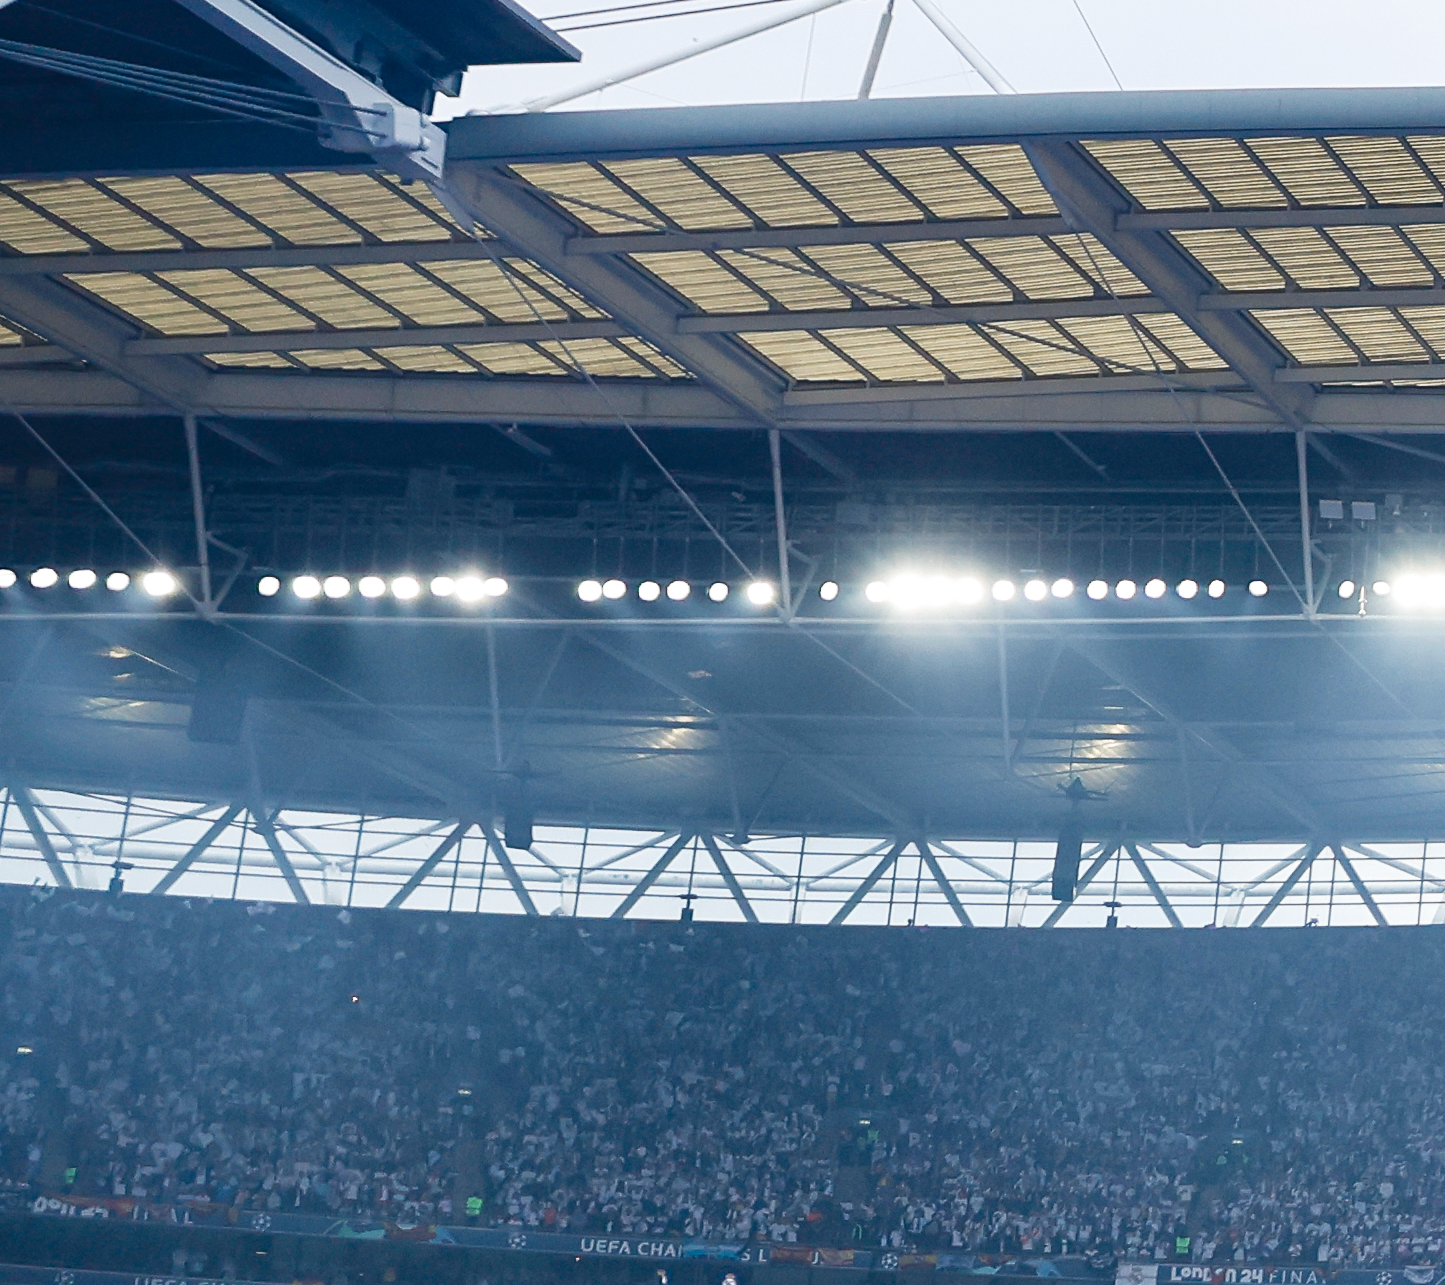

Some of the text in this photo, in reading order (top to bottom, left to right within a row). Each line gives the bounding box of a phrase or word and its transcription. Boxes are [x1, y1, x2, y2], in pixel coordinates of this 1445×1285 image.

[580, 1238, 634, 1255] UEFA
[1240, 1268, 1264, 1284] 24
[1269, 1269, 1327, 1284] FINA
